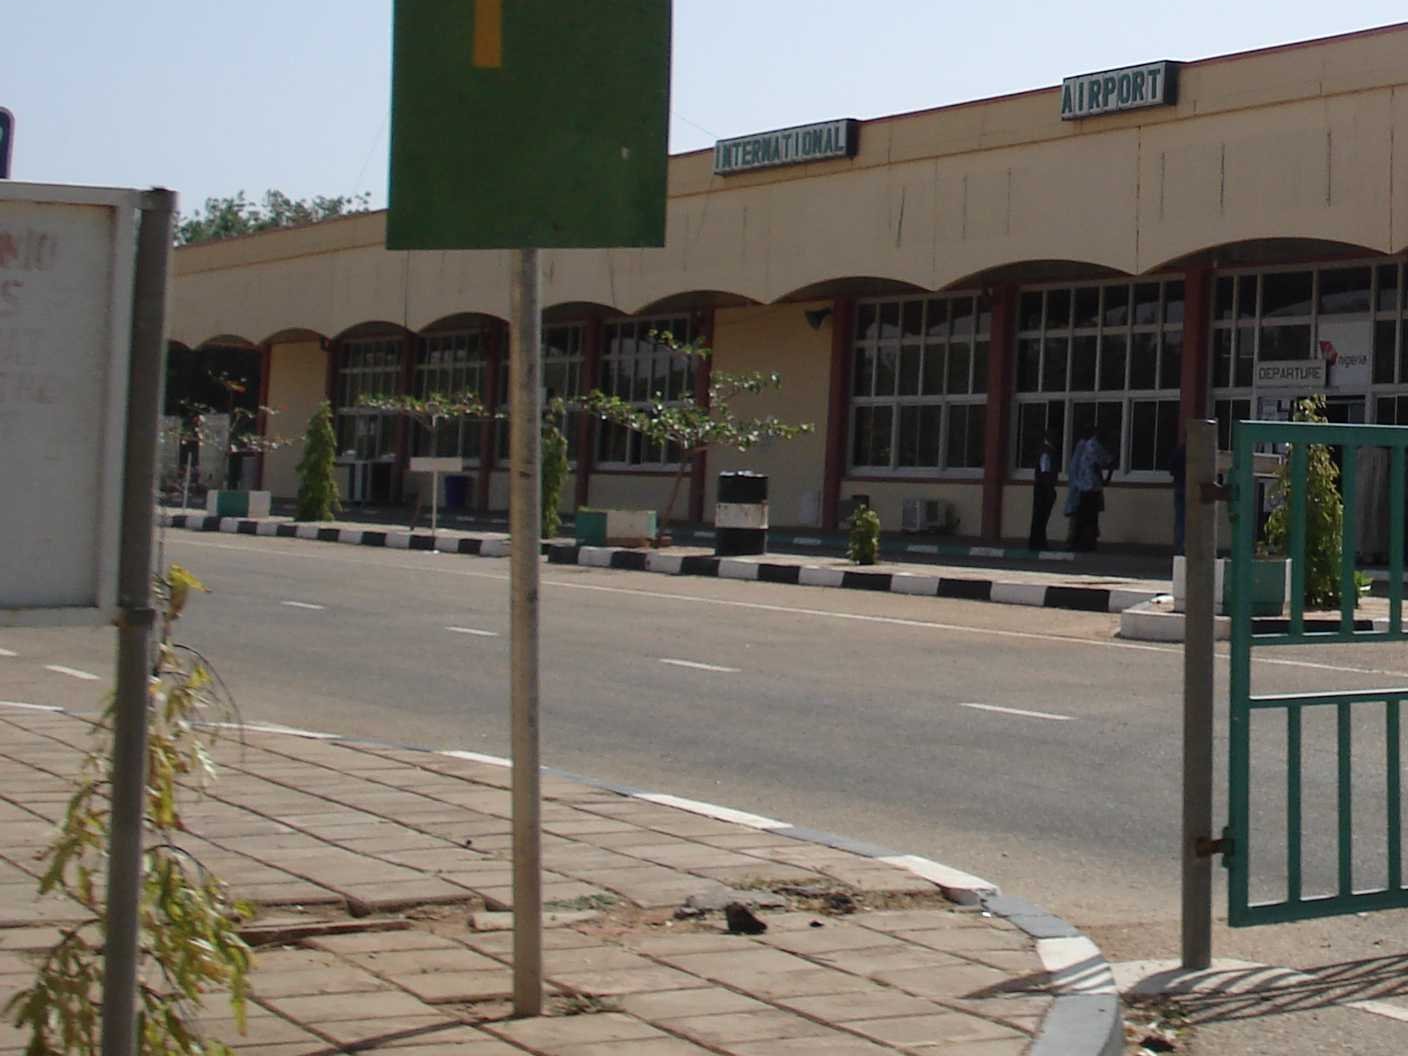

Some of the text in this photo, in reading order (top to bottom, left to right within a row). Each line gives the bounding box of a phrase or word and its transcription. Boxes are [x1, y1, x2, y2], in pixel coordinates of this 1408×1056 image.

[716, 67, 1161, 169] INTERNATIONAL AIRPORT
[1258, 366, 1322, 381] DEPARTURE
